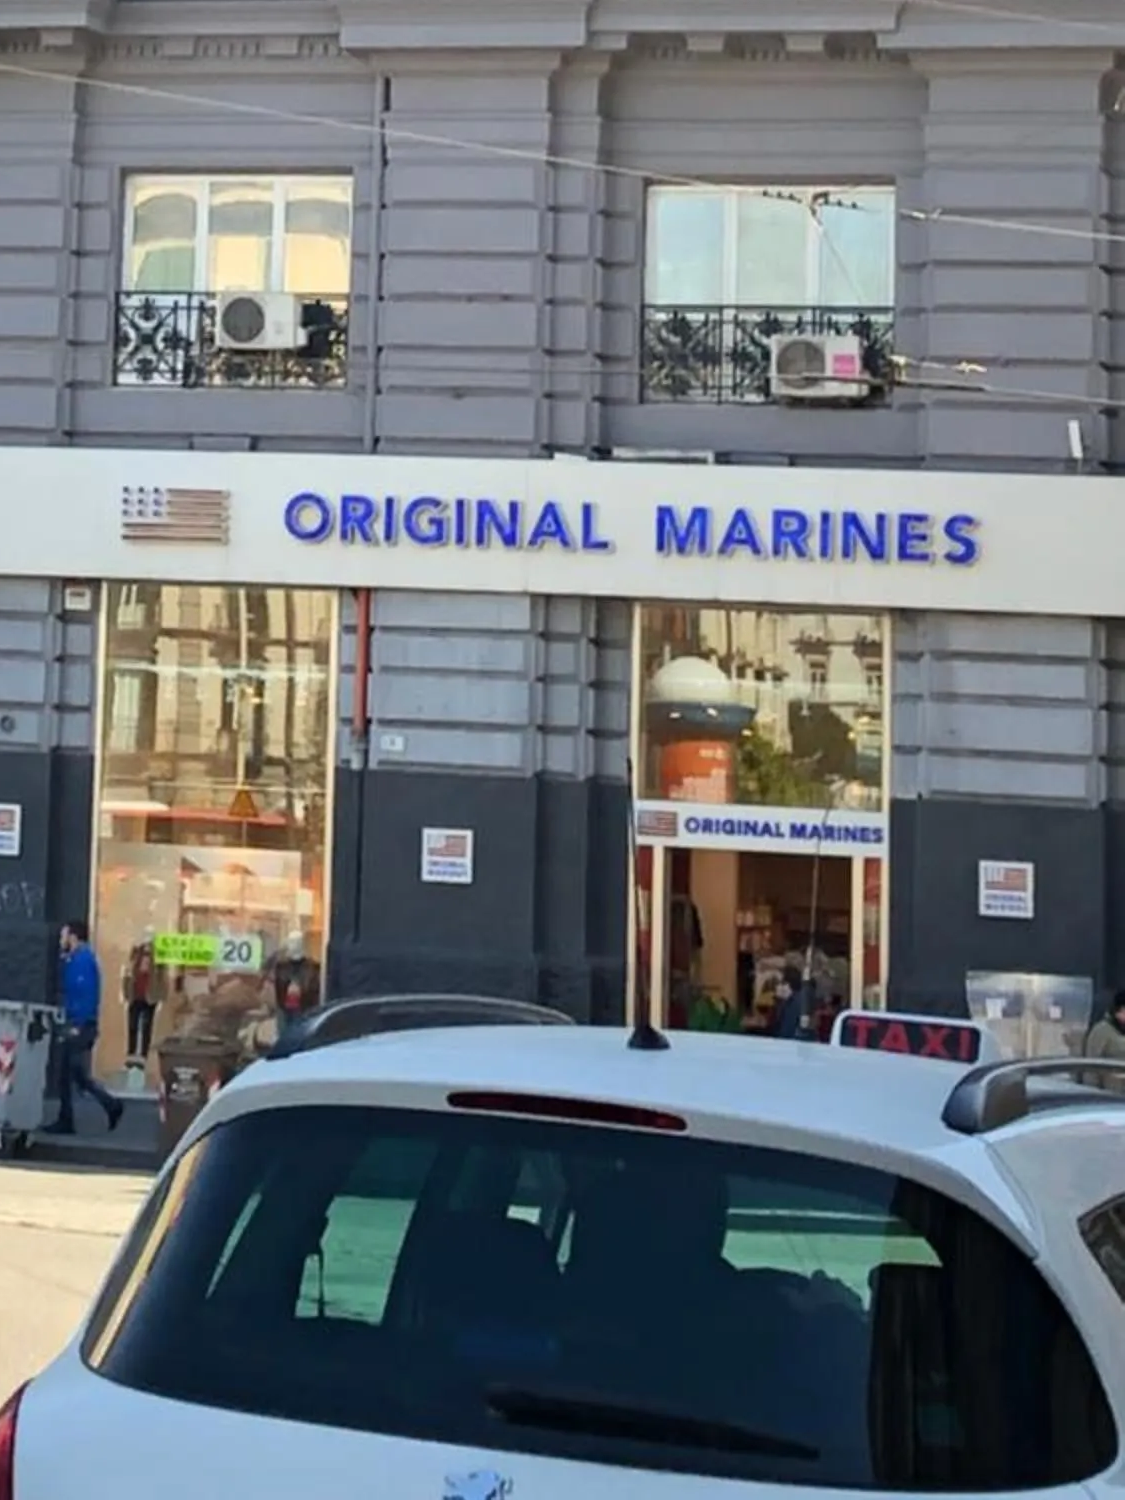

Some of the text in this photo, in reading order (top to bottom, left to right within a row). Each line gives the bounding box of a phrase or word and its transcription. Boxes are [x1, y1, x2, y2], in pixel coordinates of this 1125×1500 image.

[283, 492, 979, 565] ORIGINAL MARINES
[683, 816, 884, 844] ORIGINAL MARINES
[222, 939, 252, 963] 20
[847, 1017, 972, 1060] TAXI
